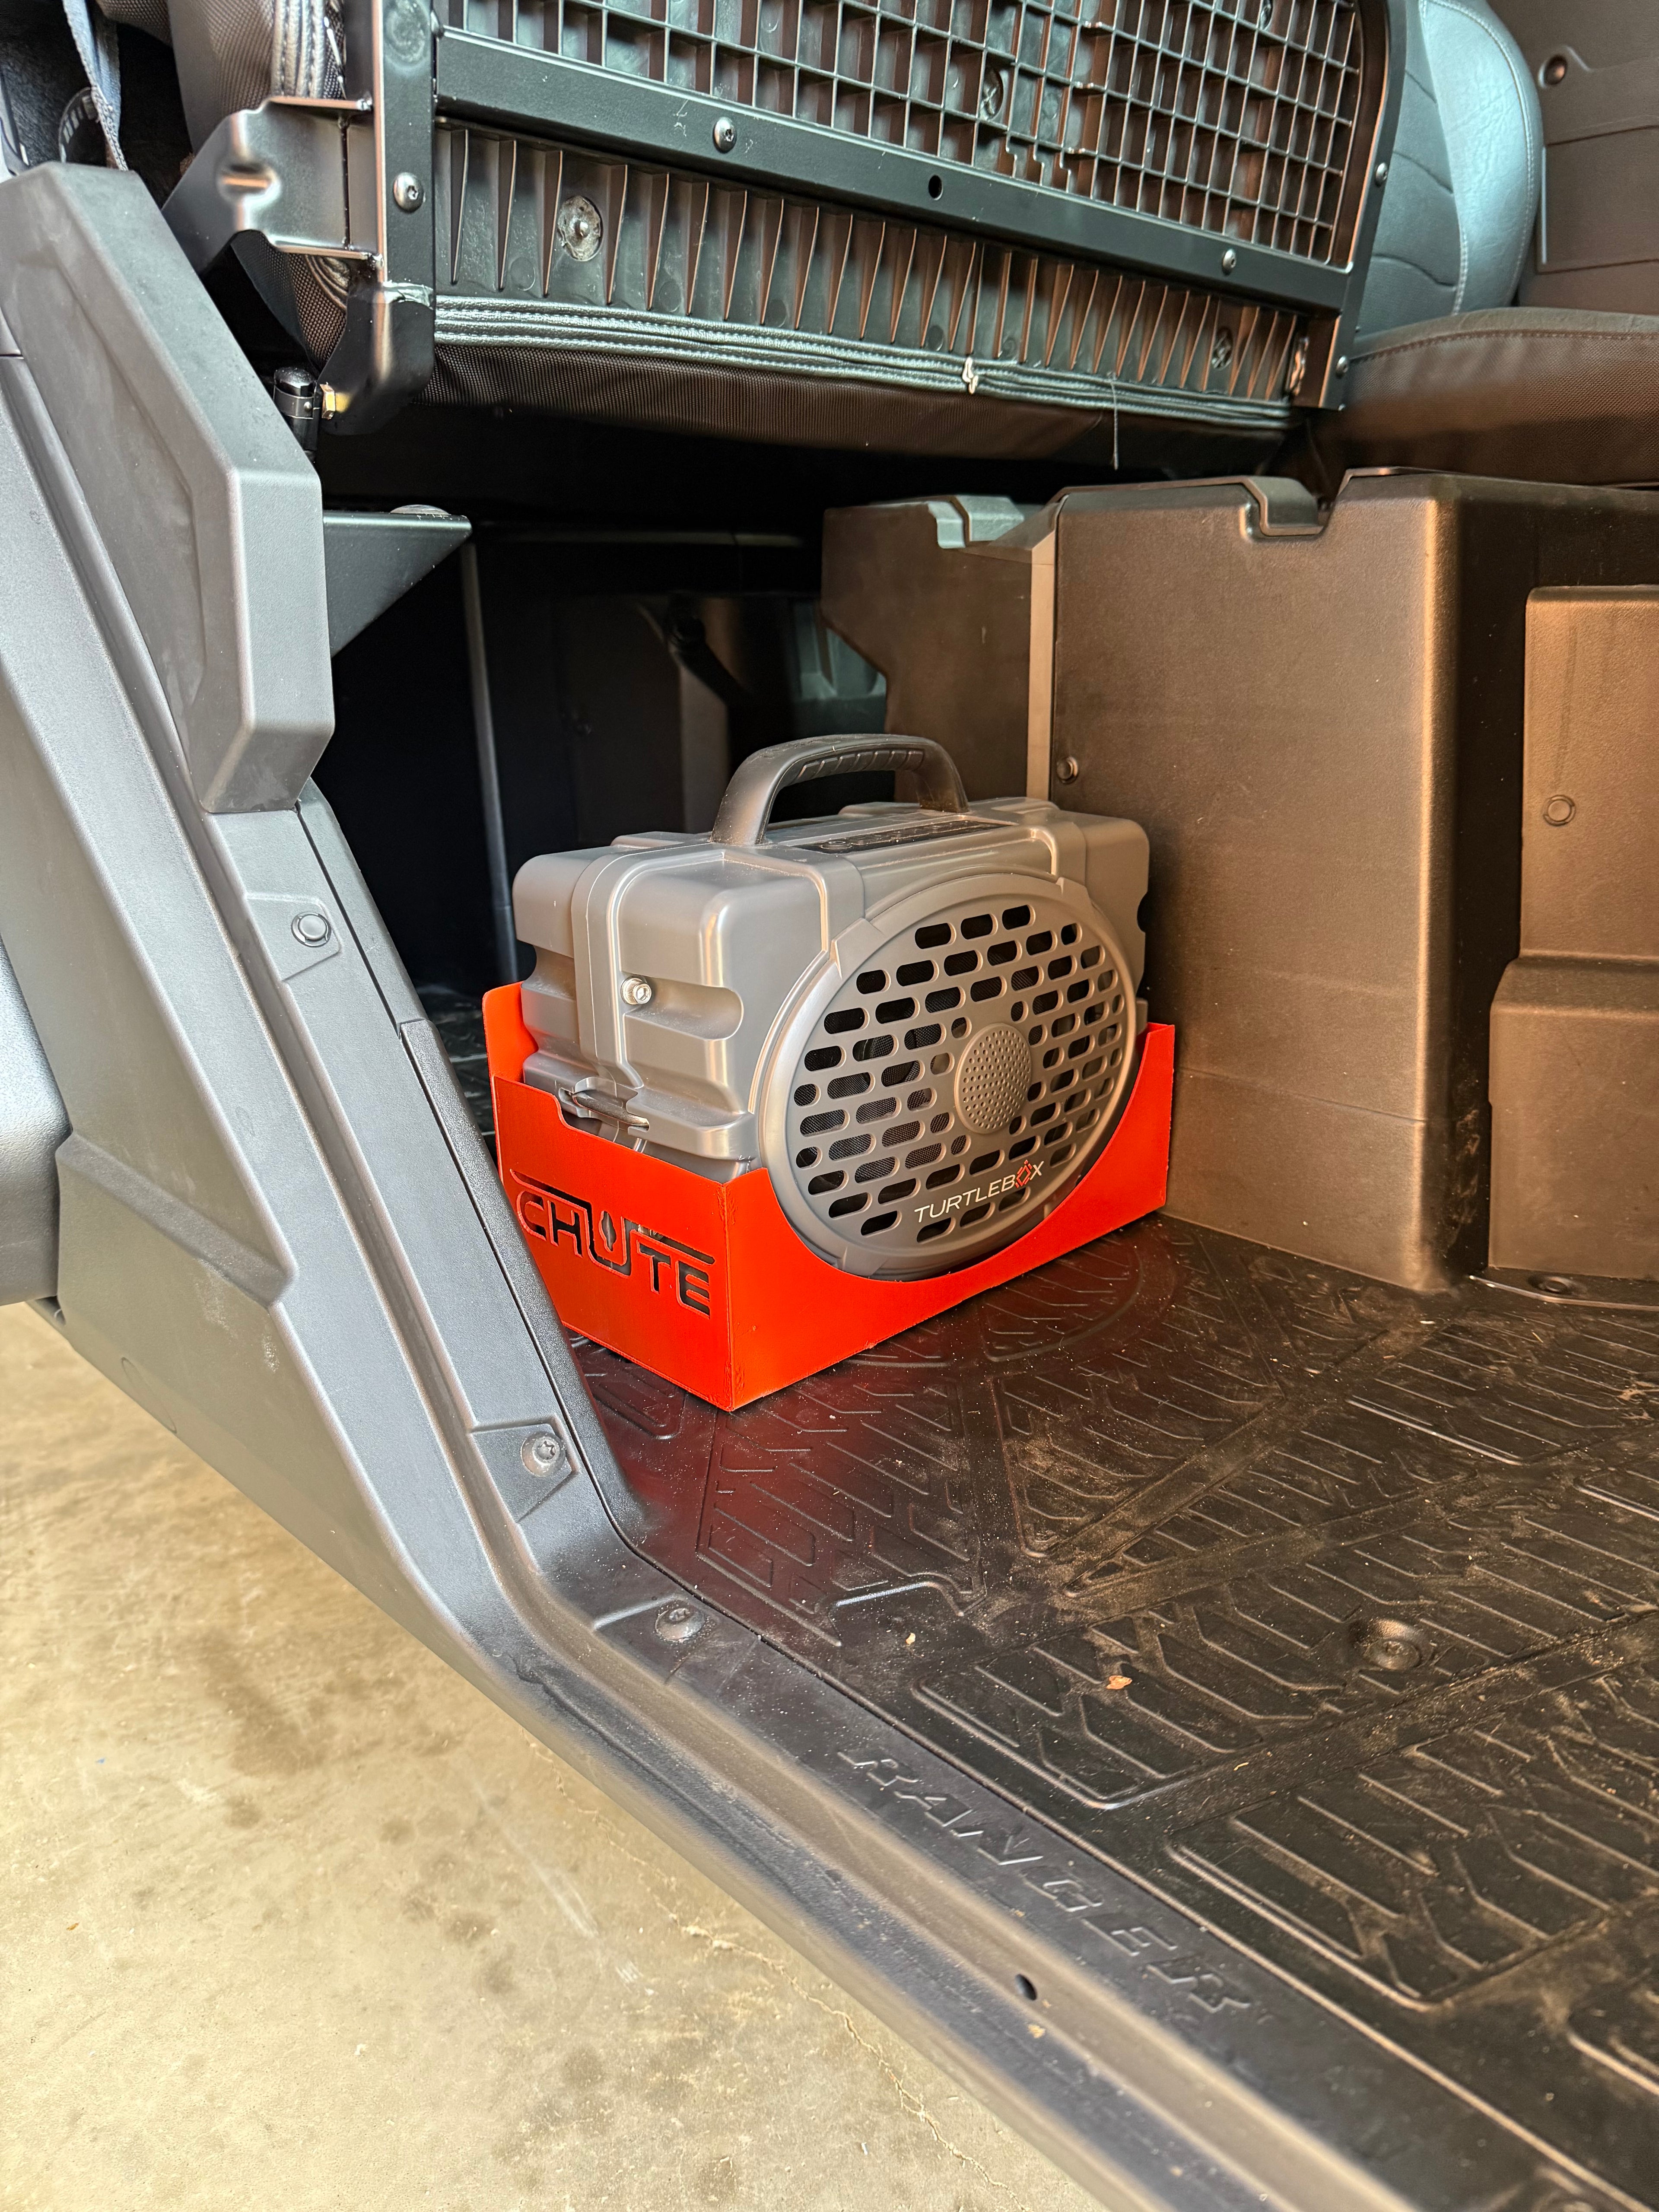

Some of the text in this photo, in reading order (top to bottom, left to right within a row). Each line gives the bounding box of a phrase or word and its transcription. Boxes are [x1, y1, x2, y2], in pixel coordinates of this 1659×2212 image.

[510, 1169, 715, 1319] CHUTE
[914, 1160, 1044, 1223] TURTLEBOX
[836, 1747, 1253, 2013] RANGER
